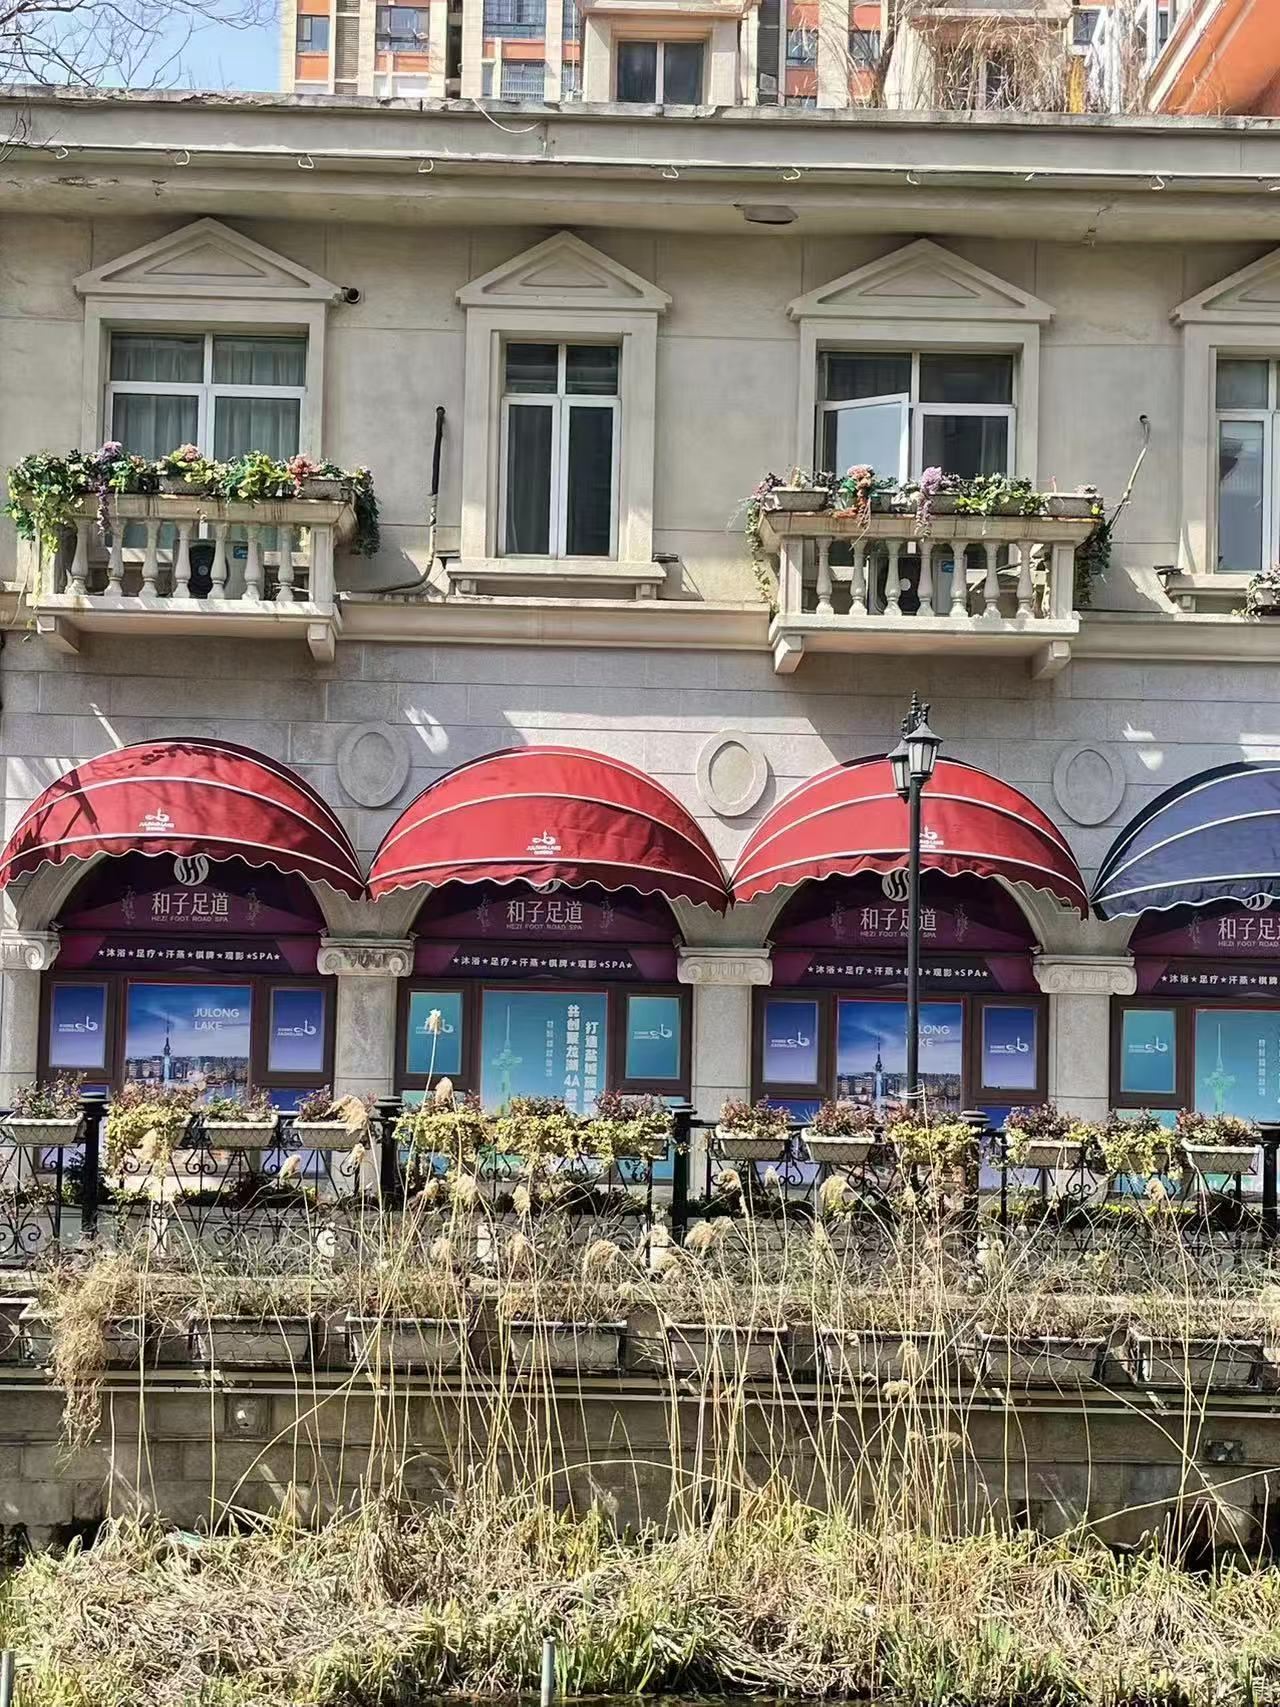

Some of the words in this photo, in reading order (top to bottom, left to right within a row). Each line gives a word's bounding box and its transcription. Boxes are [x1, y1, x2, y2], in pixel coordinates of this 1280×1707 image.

[151, 892, 229, 915] 和子足道
[506, 901, 583, 923] 和子足道
[1218, 917, 1280, 940] 和子足
[136, 948, 156, 959] 足疗
[252, 952, 273, 960] SPA
[490, 957, 509, 966] 足疗
[604, 960, 625, 968] SPA
[845, 966, 864, 975] 足疗
[960, 969, 981, 977] SPA
[1199, 975, 1218, 984] 足疗
[193, 1007, 240, 1018] JULONG
[195, 1020, 223, 1031] LAKE
[905, 1024, 950, 1035] LONG
